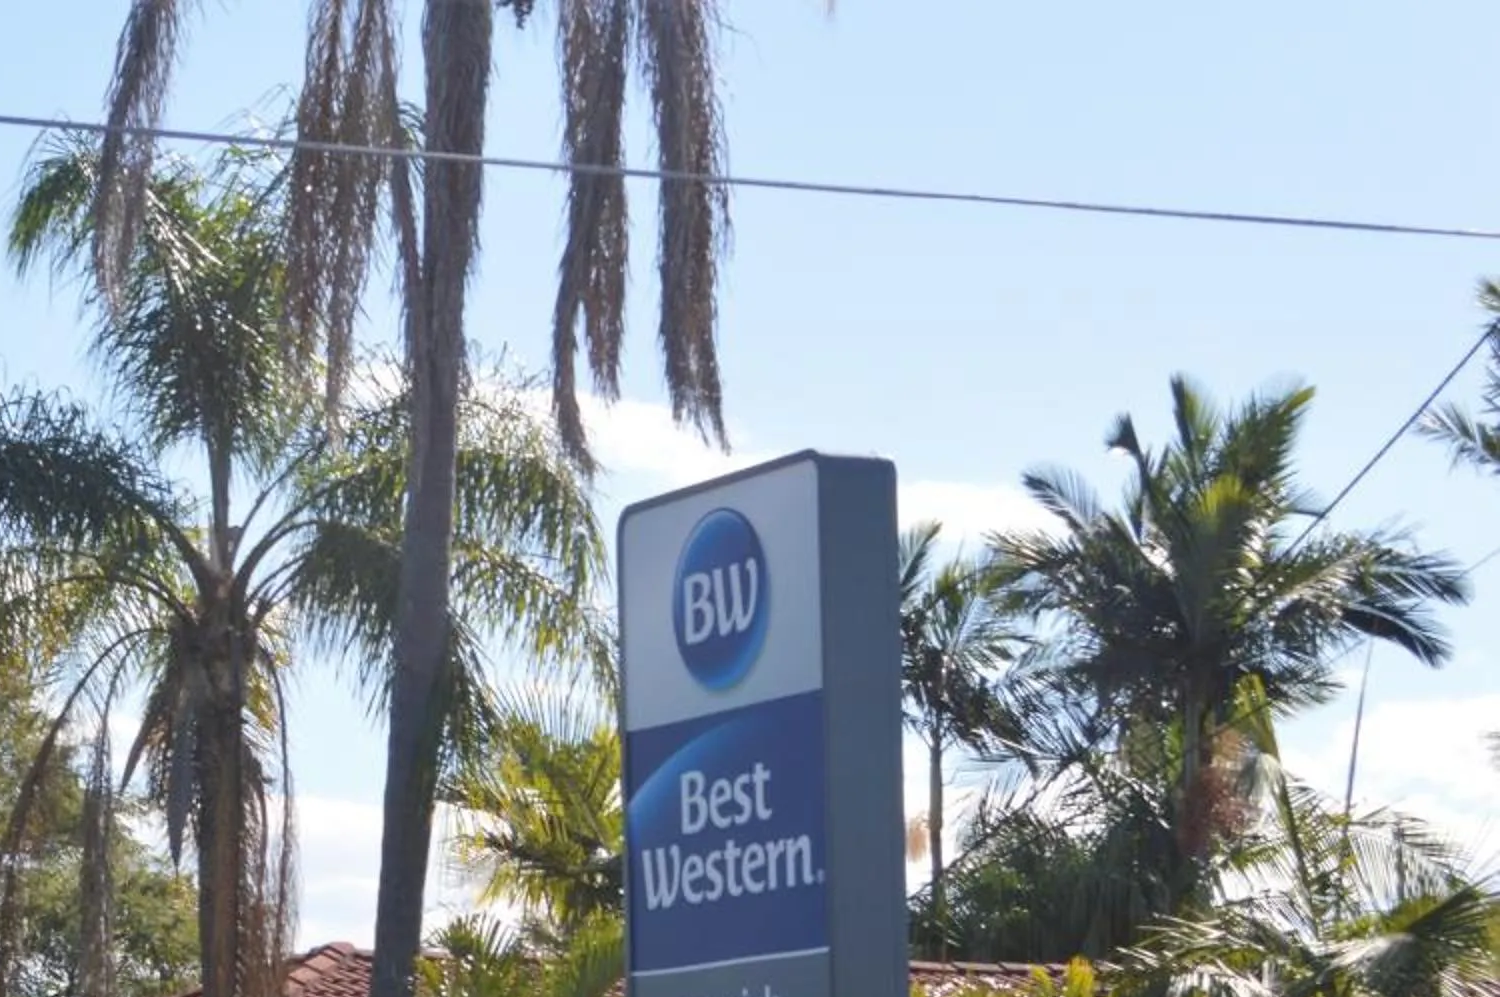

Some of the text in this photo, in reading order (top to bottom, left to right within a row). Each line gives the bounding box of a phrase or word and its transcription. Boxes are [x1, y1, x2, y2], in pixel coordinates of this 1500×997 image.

[683, 558, 759, 646] BW
[680, 762, 772, 835] Best
[641, 834, 816, 911] Western
